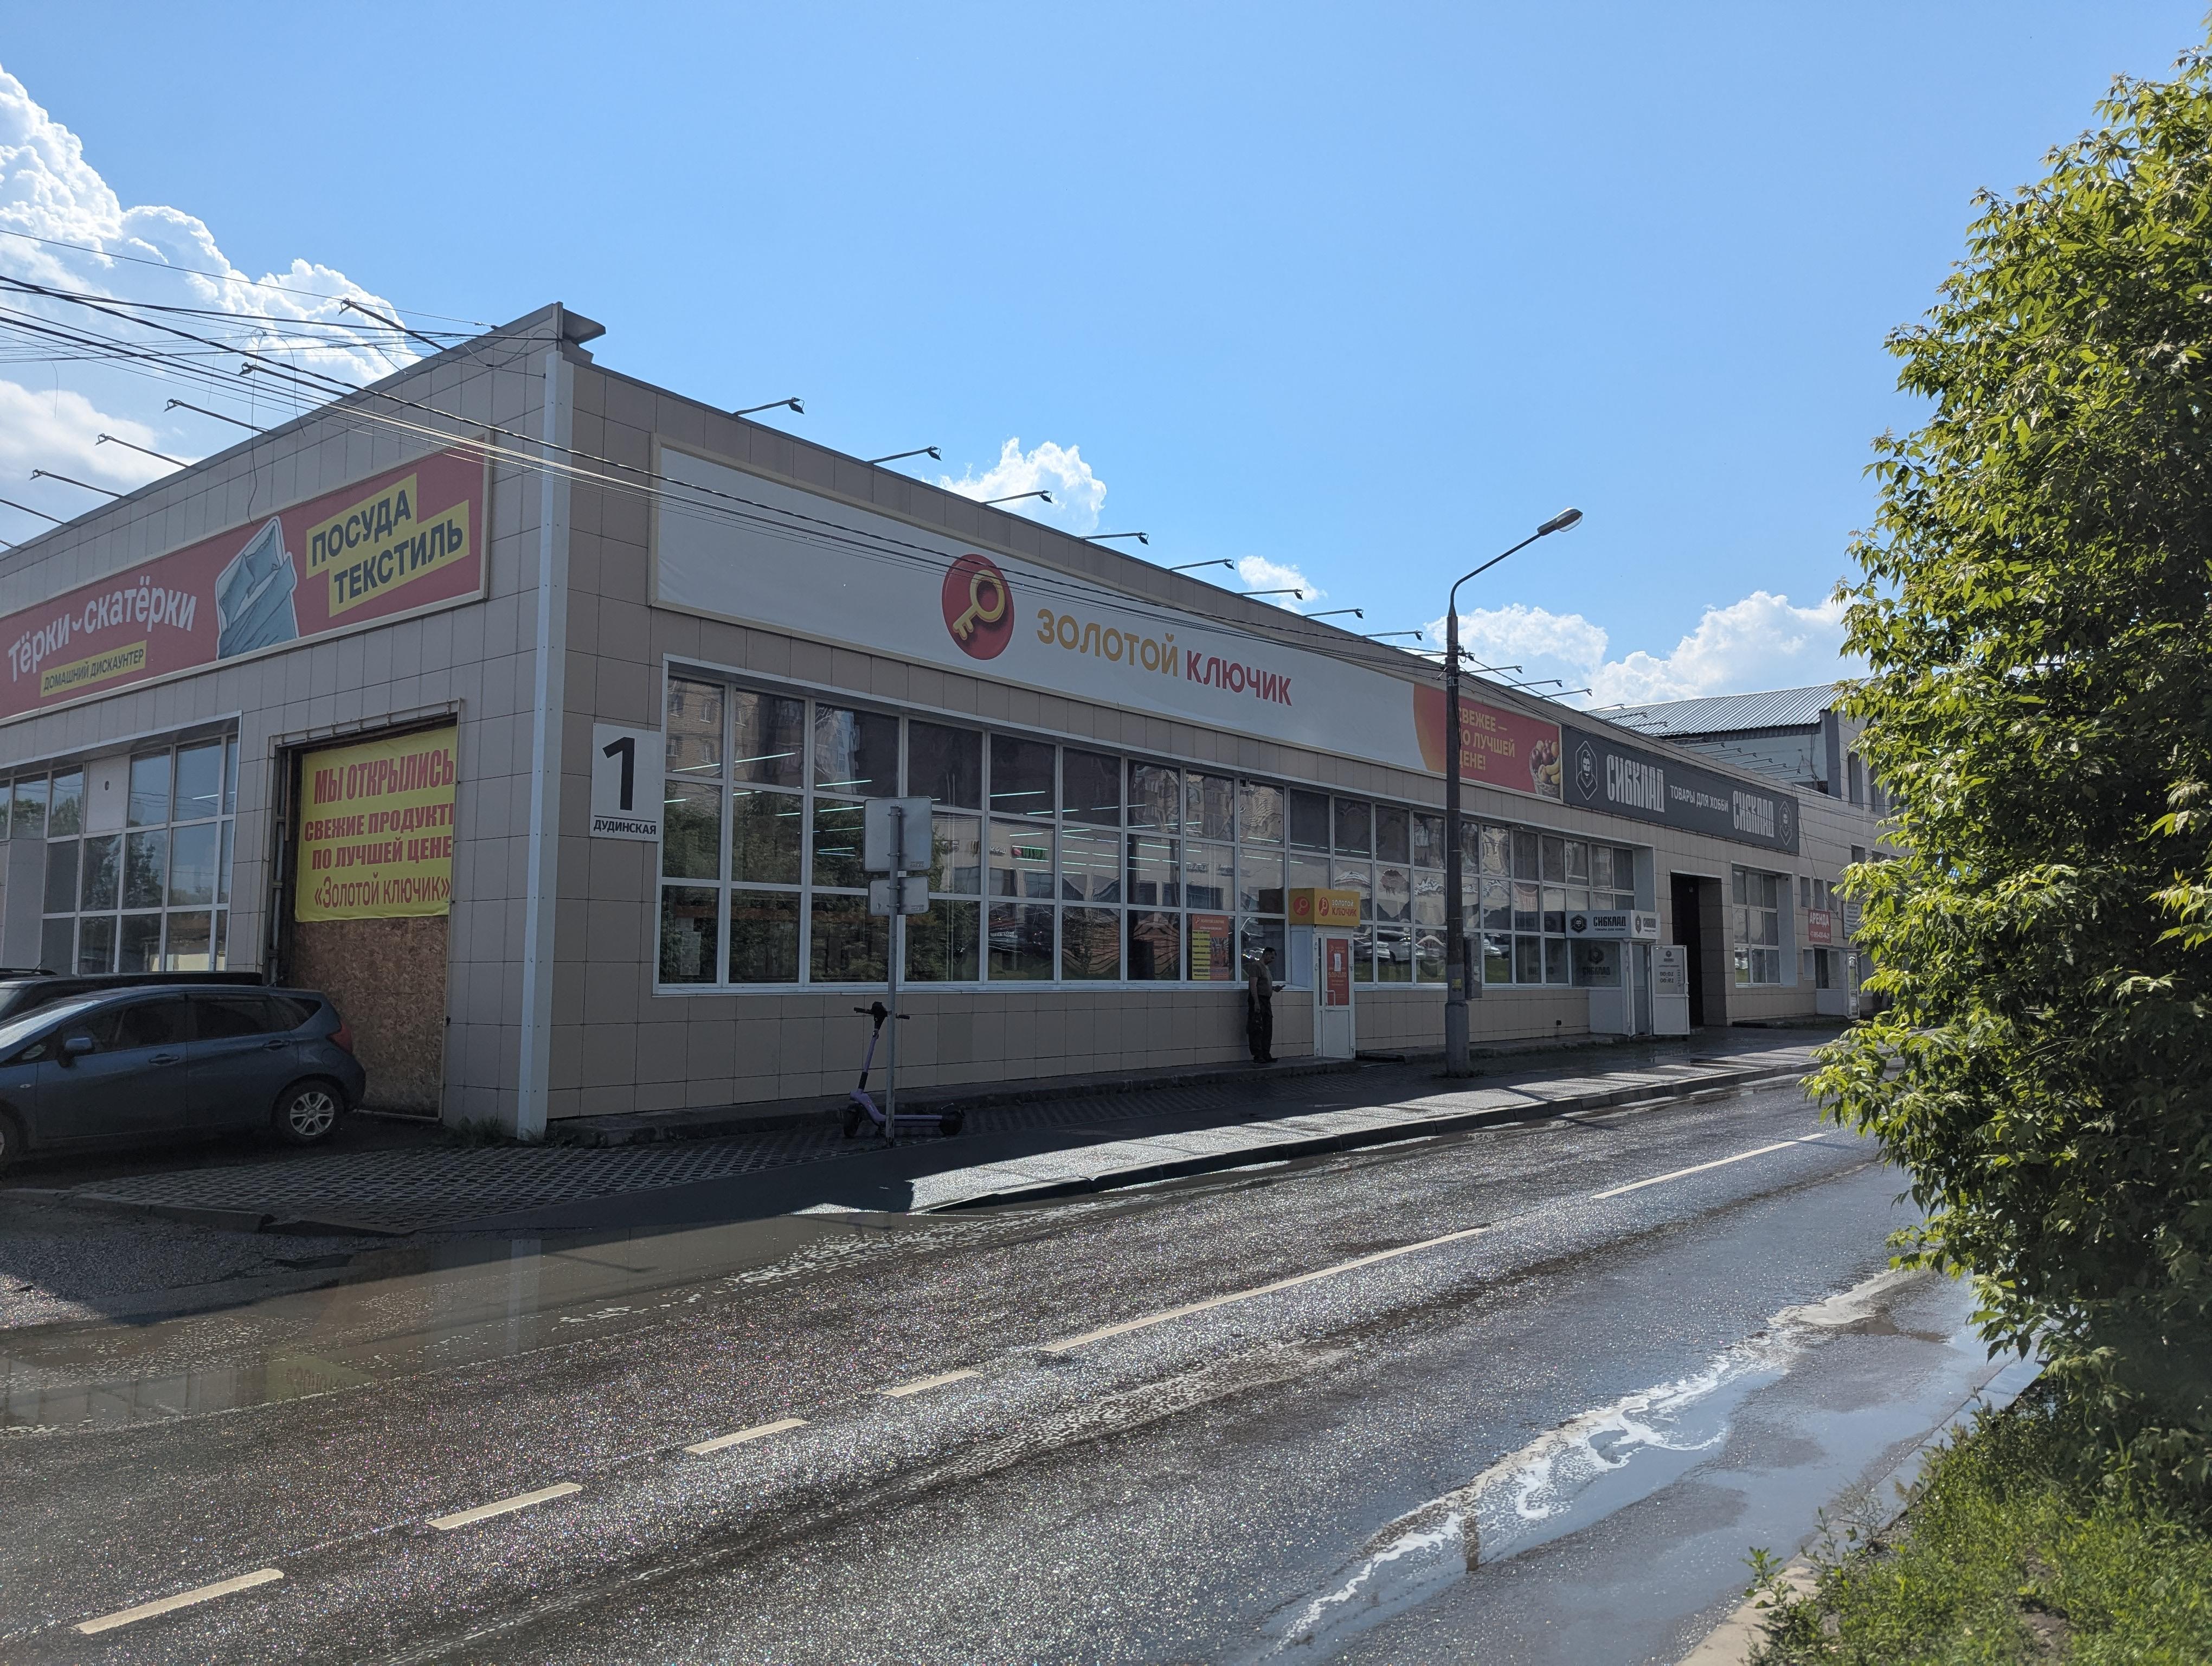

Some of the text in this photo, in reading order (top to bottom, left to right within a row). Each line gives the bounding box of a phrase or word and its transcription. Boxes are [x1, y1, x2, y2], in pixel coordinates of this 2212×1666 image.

[312, 489, 411, 567] ПОСУДА
[334, 519, 463, 604] ТЕКСТИЛЬ
[43, 649, 144, 692] ДОМАШНИЙ ДИСКАУНТЕР
[1037, 608, 1292, 706] ЗОЛОТОЙ КЛЮЧИК
[1459, 707, 1496, 732] ВЕЖЕЕ
[1473, 733, 1515, 757] ЛУЧШЕЙ
[314, 748, 454, 804] МЫ ОТКРЫЛИСЬ
[602, 736, 635, 811] 1
[1606, 754, 1665, 813] СИБКЛАД
[1670, 785, 1728, 812] ТОВАРЫ ДЛЯ ХОББИ
[1733, 790, 1774, 838] СИБКЛАД
[305, 815, 364, 842] СВЕЖИЕ
[594, 819, 657, 835] ДУДИНСКАЯ
[312, 835, 452, 870] ПО ЛУЧШЕЙ ЦЕНЕ
[1332, 907, 1357, 917] КЛЮЧИК
[1593, 916, 1627, 927] СИБКЛАД
[1809, 912, 1830, 928] АРЕНДА
